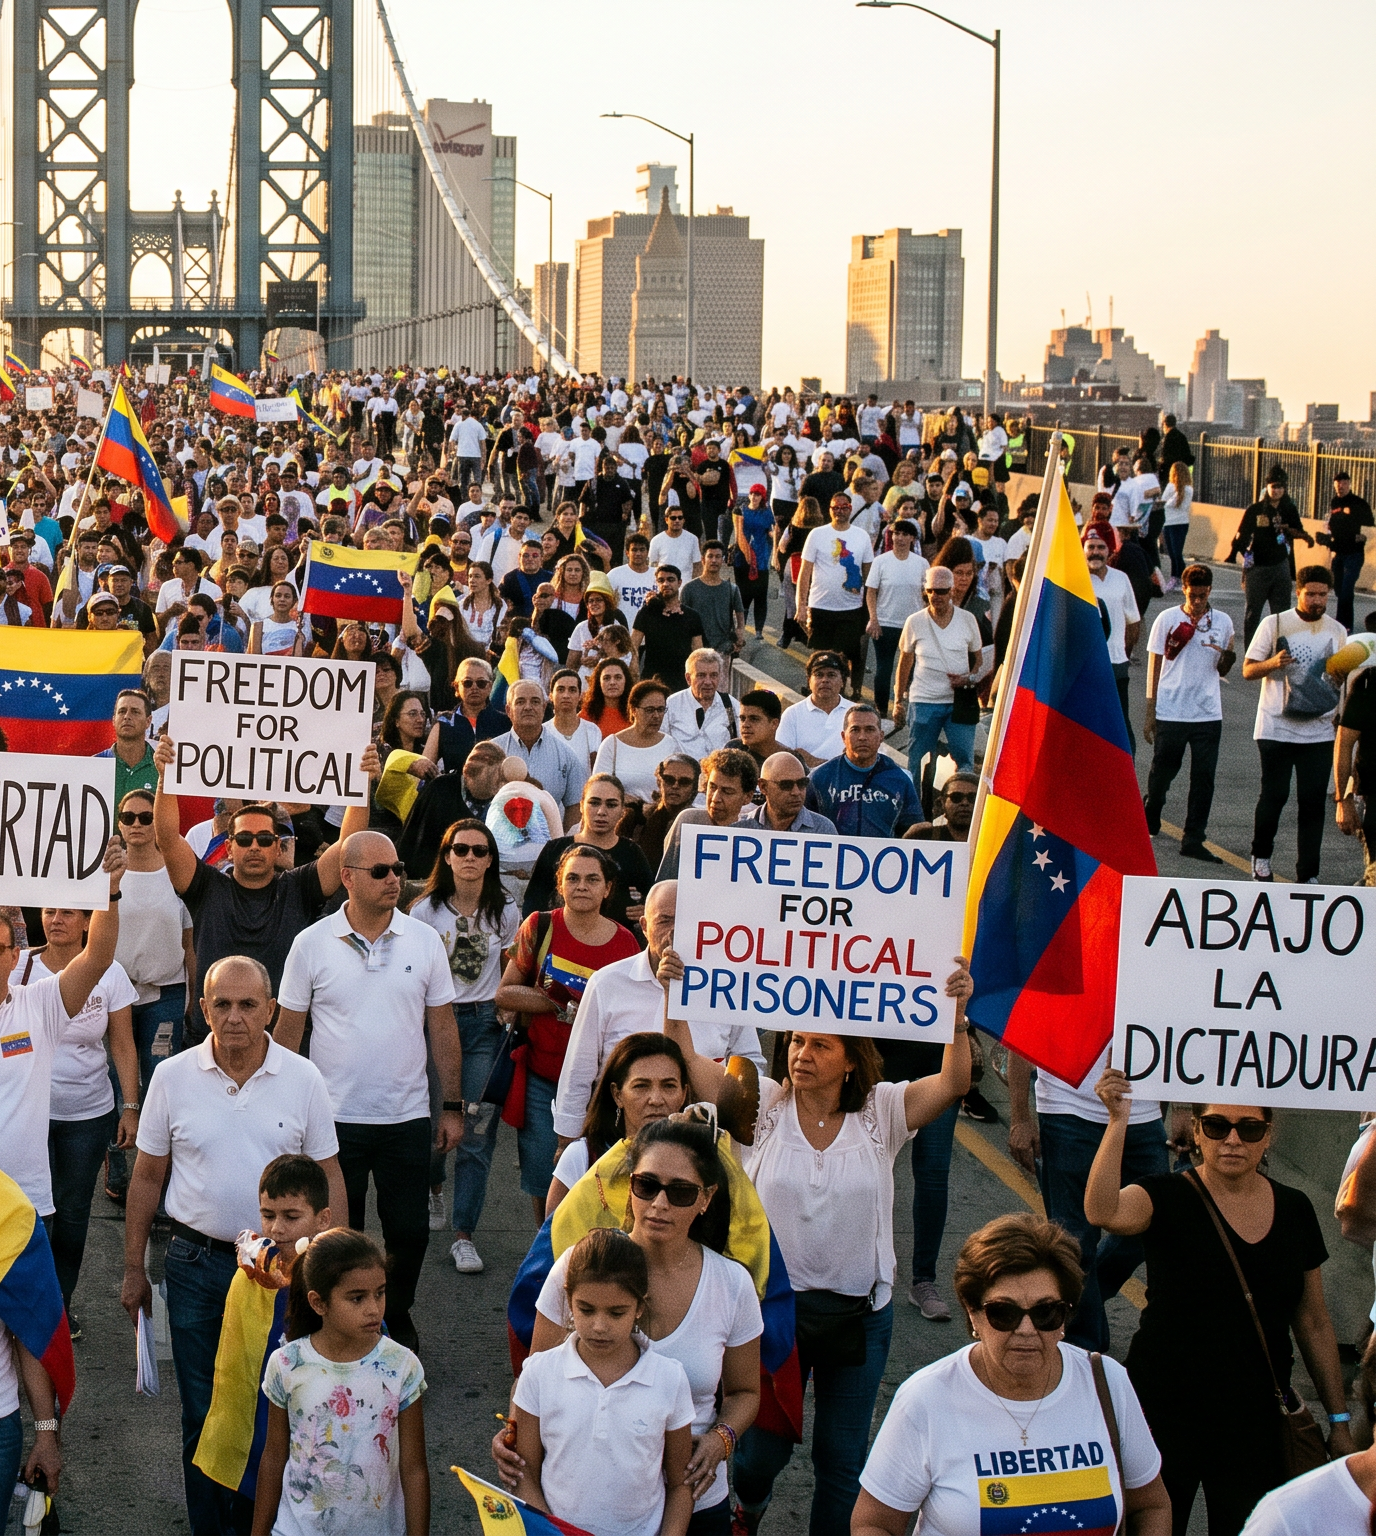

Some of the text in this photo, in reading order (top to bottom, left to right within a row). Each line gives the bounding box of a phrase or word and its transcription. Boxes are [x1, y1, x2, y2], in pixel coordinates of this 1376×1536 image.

[178, 658, 367, 714] FREEDOM
[236, 712, 299, 742] FOR
[176, 742, 364, 798] POLITICAL
[694, 833, 954, 898] FREEDOM
[779, 893, 853, 927] FOR
[1144, 888, 1365, 956] ABAJO
[695, 921, 933, 978] POLITICAL
[680, 965, 939, 1027] PRISONERS
[1213, 968, 1282, 1011] LA
[974, 1441, 1105, 1477] LIBERTAD
